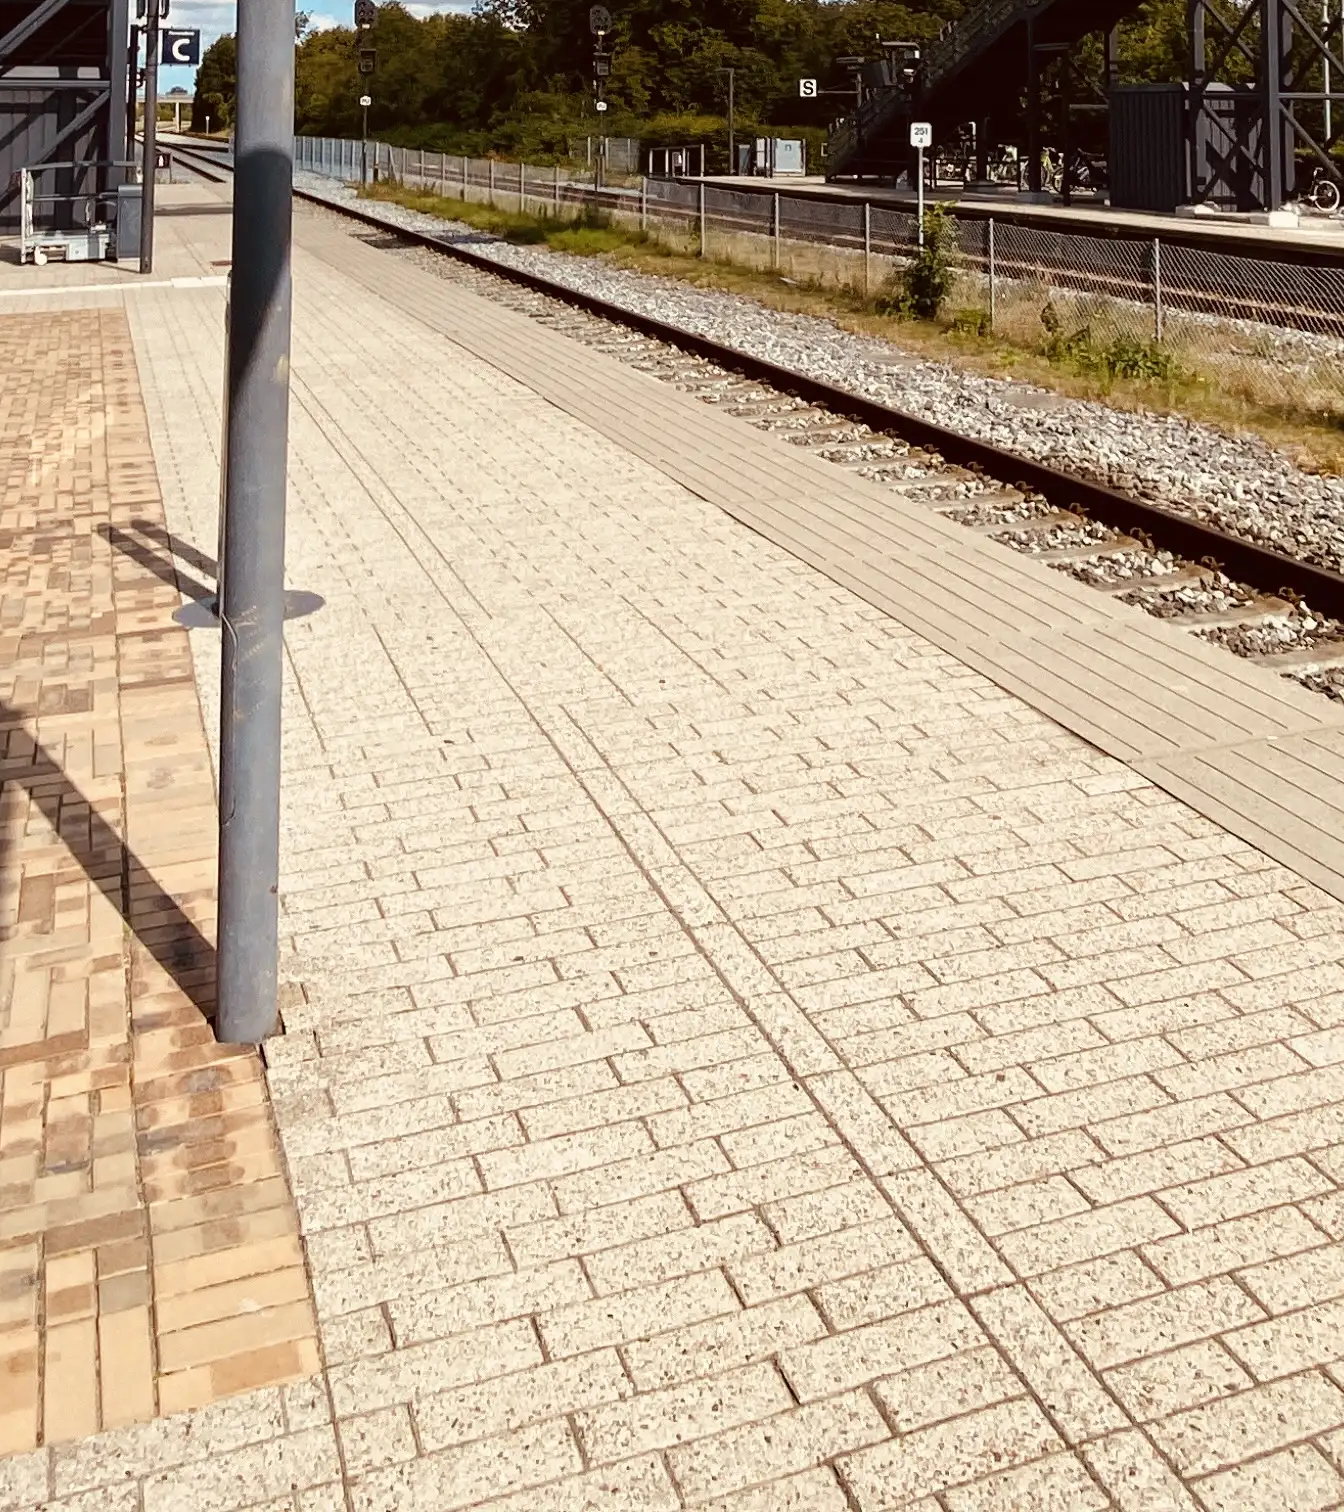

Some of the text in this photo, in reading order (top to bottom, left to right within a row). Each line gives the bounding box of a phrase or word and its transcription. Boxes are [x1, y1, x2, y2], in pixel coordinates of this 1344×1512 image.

[172, 38, 190, 62] C
[802, 80, 814, 96] S
[914, 126, 928, 136] 251
